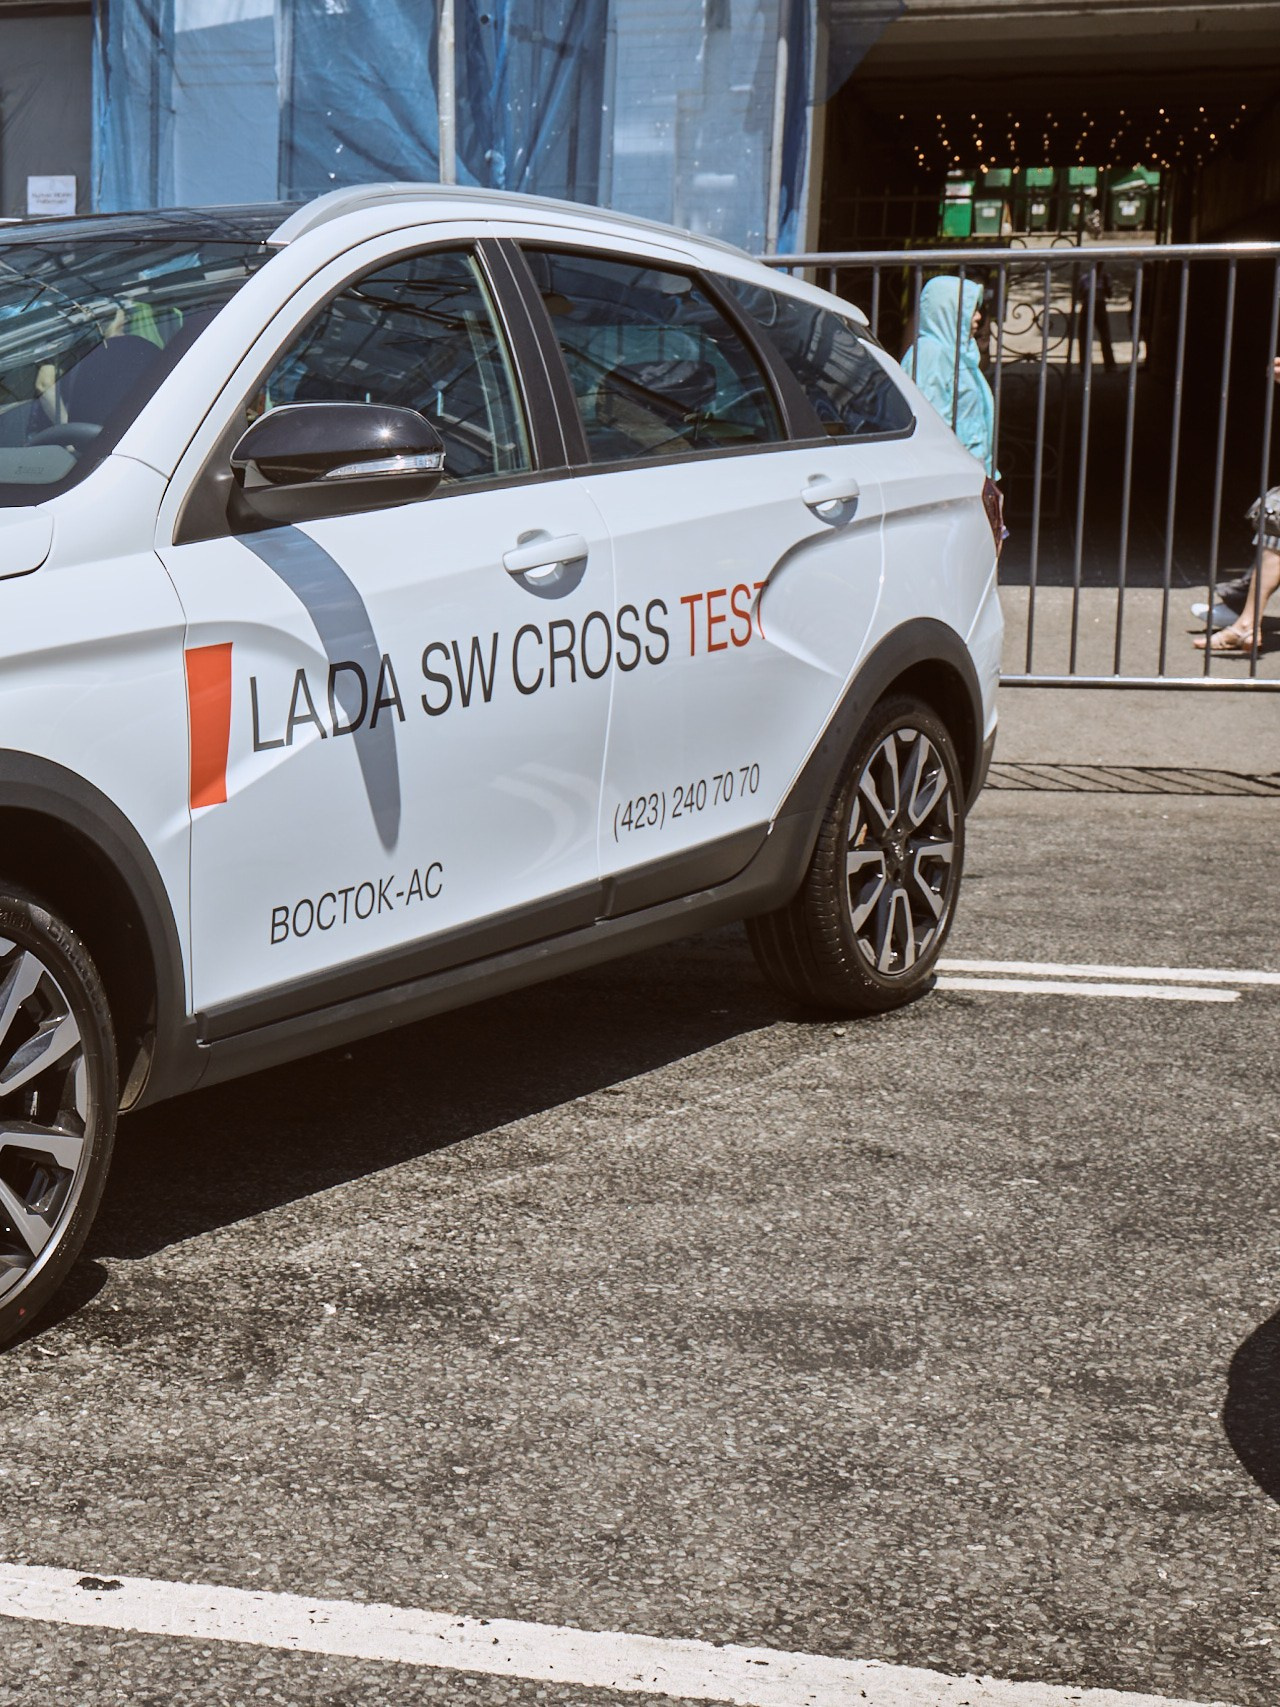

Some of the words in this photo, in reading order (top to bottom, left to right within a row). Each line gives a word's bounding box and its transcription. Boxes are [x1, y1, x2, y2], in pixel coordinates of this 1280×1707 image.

[249, 653, 406, 753] LADA
[421, 632, 498, 716] SW
[512, 598, 670, 695] CROSS
[680, 581, 770, 657] TEST
[613, 791, 666, 843] (423)
[672, 779, 707, 819] 240
[713, 771, 734, 806] 70
[739, 763, 760, 797] 70
[270, 862, 443, 945] ВОСТОК-АС
